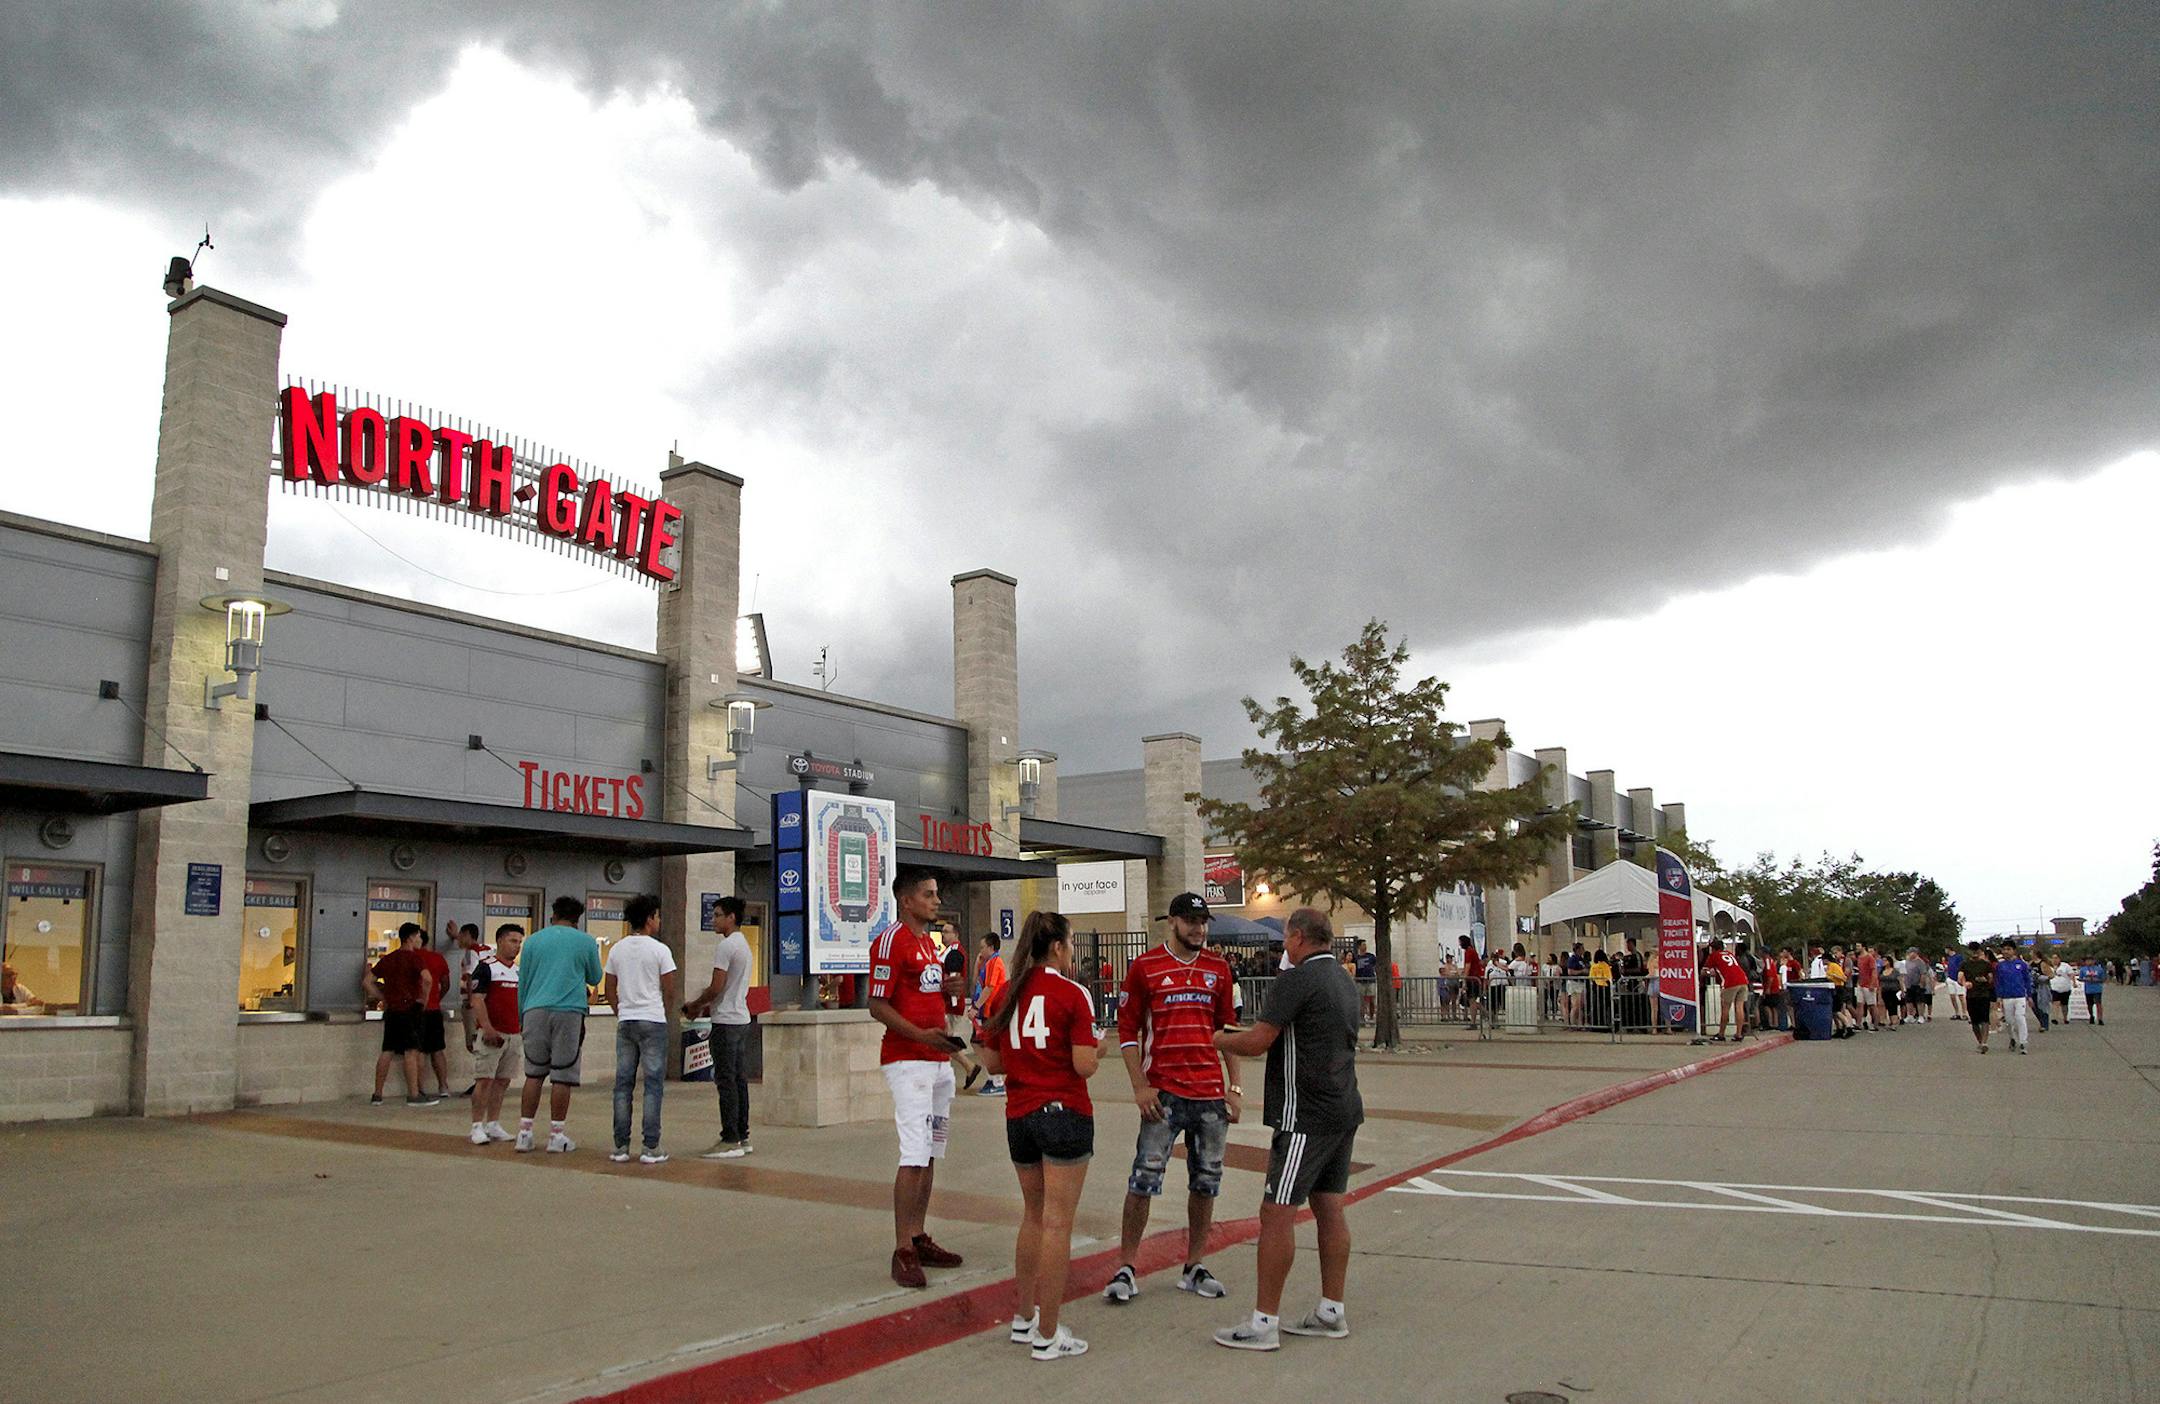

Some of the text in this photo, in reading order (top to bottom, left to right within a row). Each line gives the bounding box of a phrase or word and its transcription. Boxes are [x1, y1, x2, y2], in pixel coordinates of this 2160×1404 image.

[281, 386, 683, 582] NORTH GATE
[810, 761, 875, 781] TOYOTA STADIUM
[519, 760, 644, 819] TICKETS
[919, 814, 993, 857] TICKETS
[22, 867, 31, 881] 8
[11, 885, 35, 894] WILL
[39, 887, 63, 896] CALL
[378, 886, 390, 899] 10
[780, 886, 801, 894] TOYOTA
[1061, 880, 1118, 892] in your face
[592, 898, 604, 910] 12
[1003, 918, 1012, 938] 3
[1663, 929, 1689, 937] TICKET
[1664, 949, 1688, 959] GATE
[1660, 967, 1693, 979] ONLY
[1009, 995, 1050, 1049] 14
